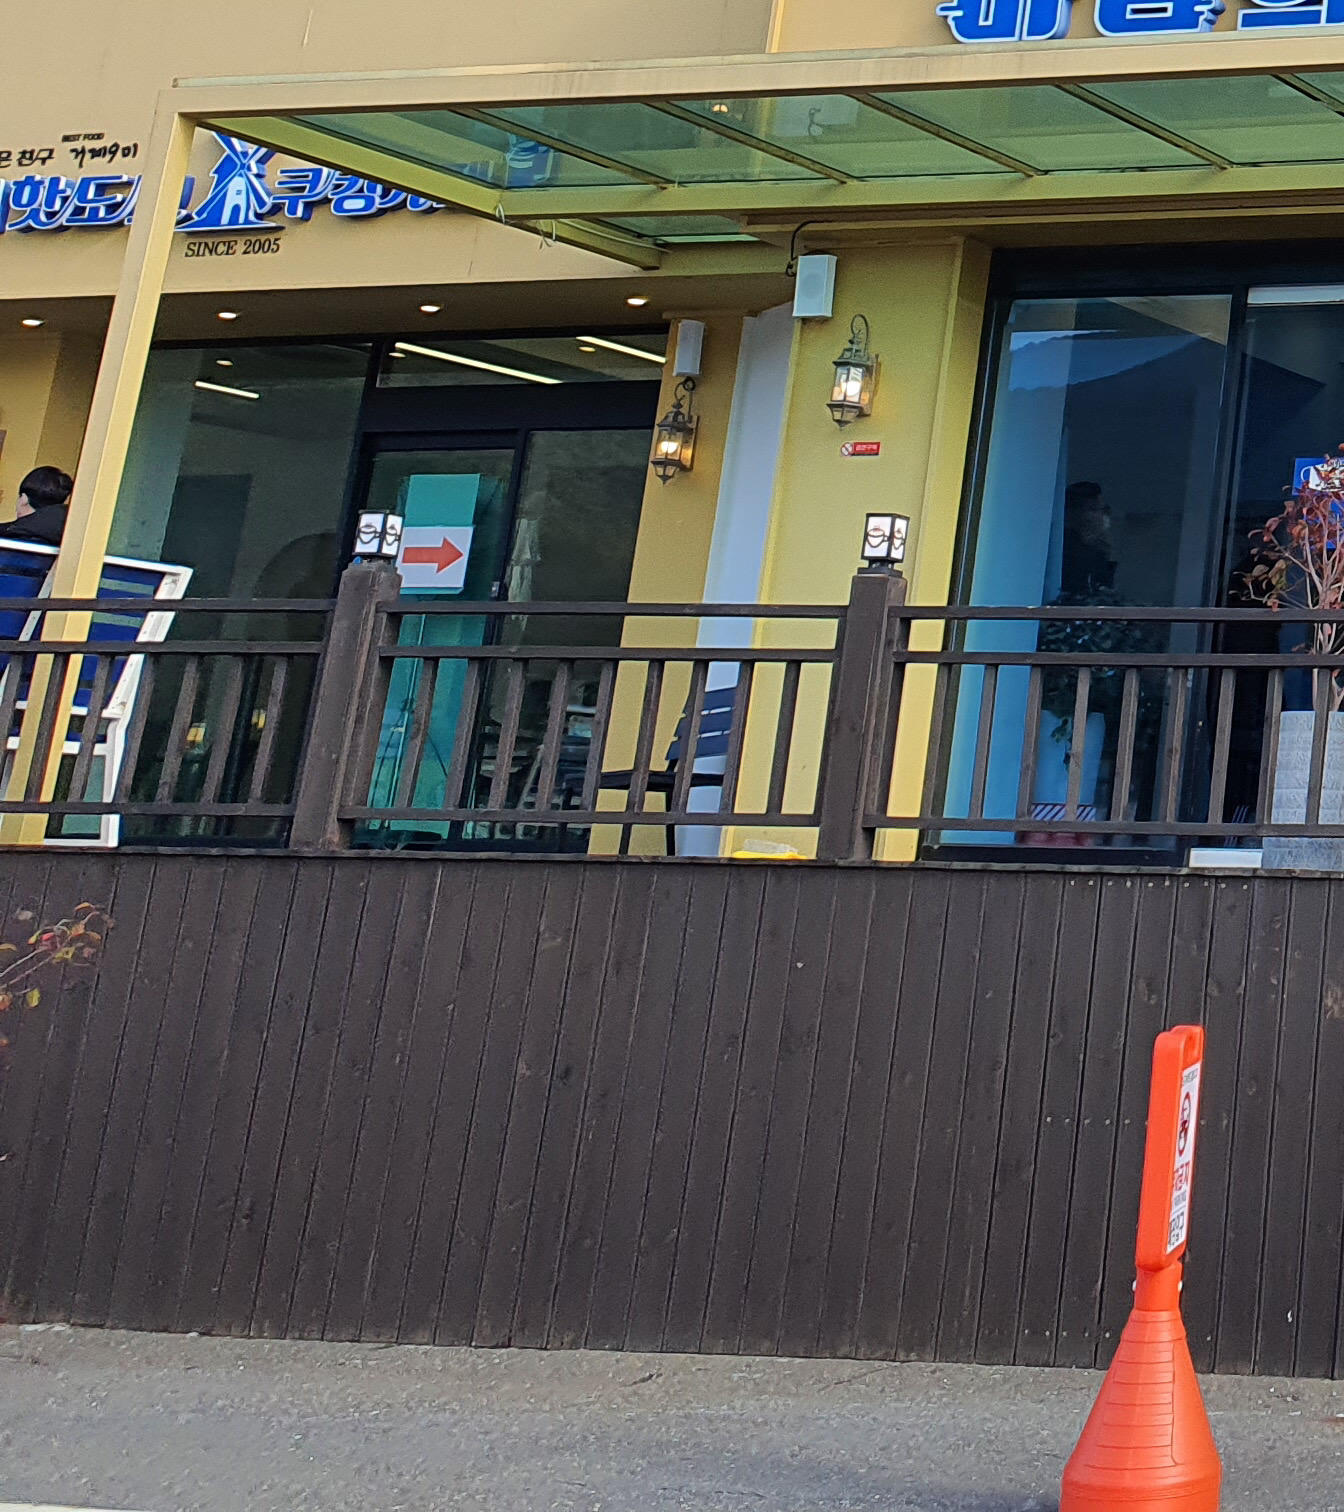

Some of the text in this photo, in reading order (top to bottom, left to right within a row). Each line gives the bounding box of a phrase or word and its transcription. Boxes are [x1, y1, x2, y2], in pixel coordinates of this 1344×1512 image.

[83, 132, 105, 142] FOOD
[16, 148, 55, 167] 친구
[184, 237, 281, 258] SINCE 2005
